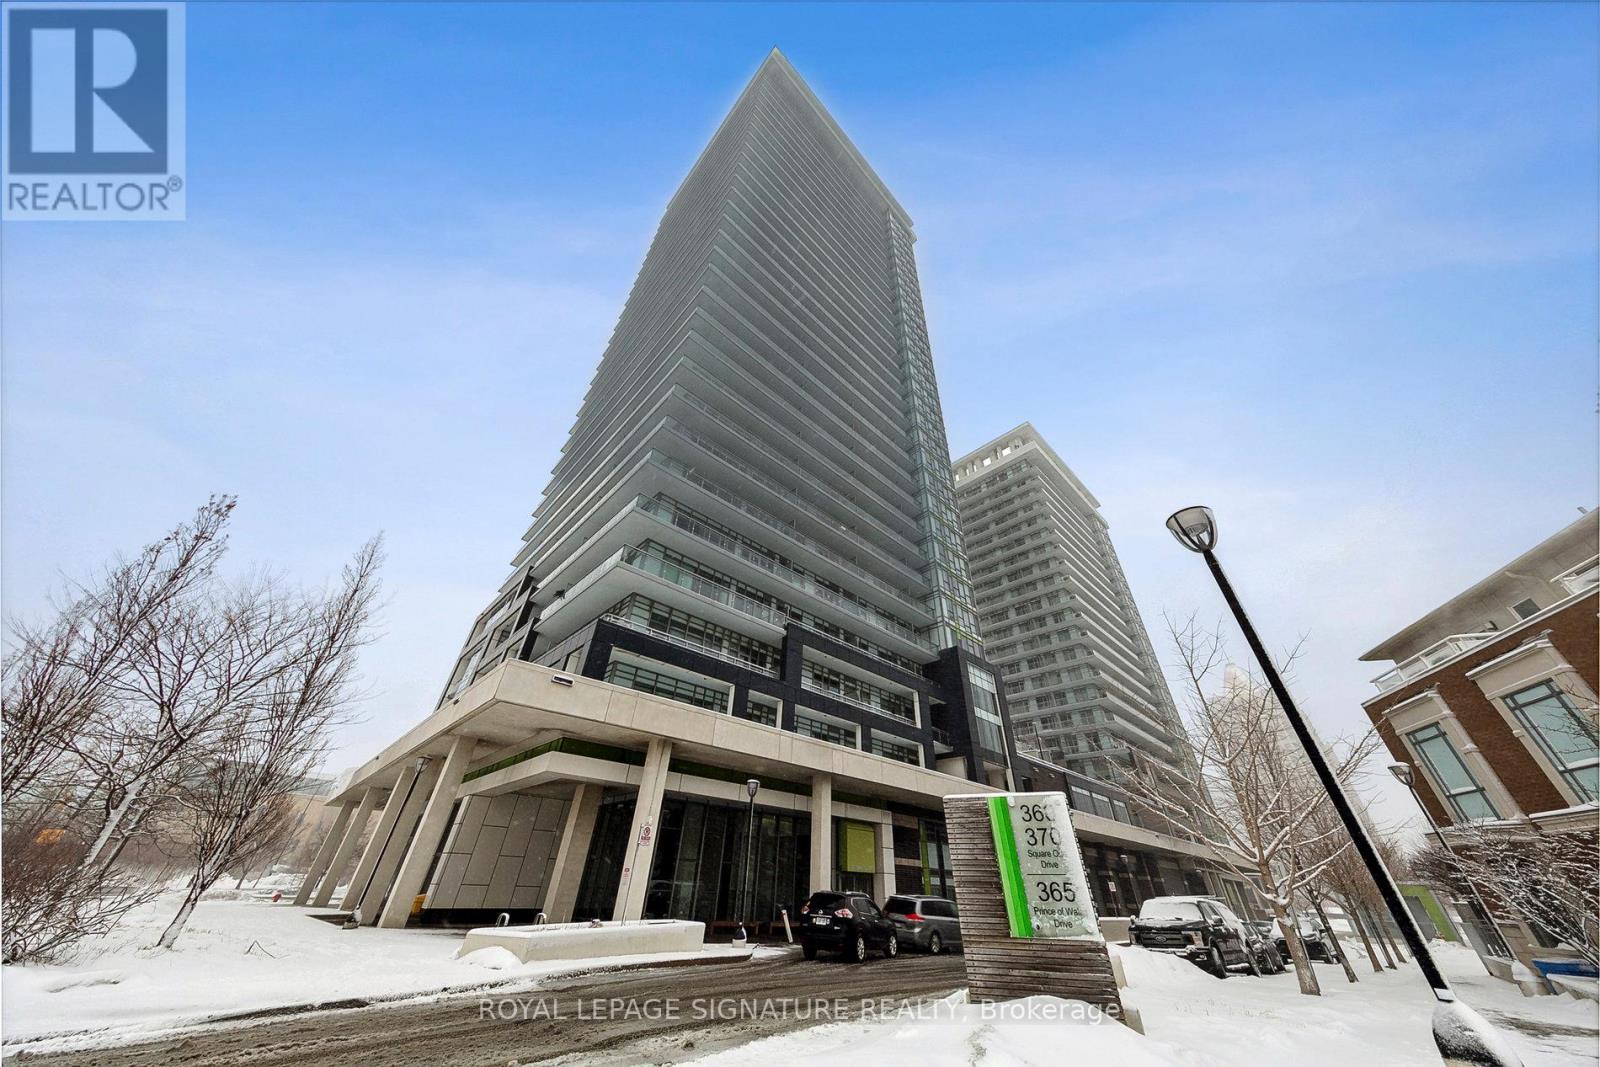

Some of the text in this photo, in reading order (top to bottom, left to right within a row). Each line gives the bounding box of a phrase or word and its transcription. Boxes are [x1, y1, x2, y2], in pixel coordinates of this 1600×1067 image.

[1025, 827, 1061, 846] 370
[1027, 849, 1052, 859] Square
[1040, 860, 1059, 869] Drive
[1036, 881, 1076, 902] 365
[1033, 906, 1056, 916] Prince
[1053, 919, 1073, 929] Drive
